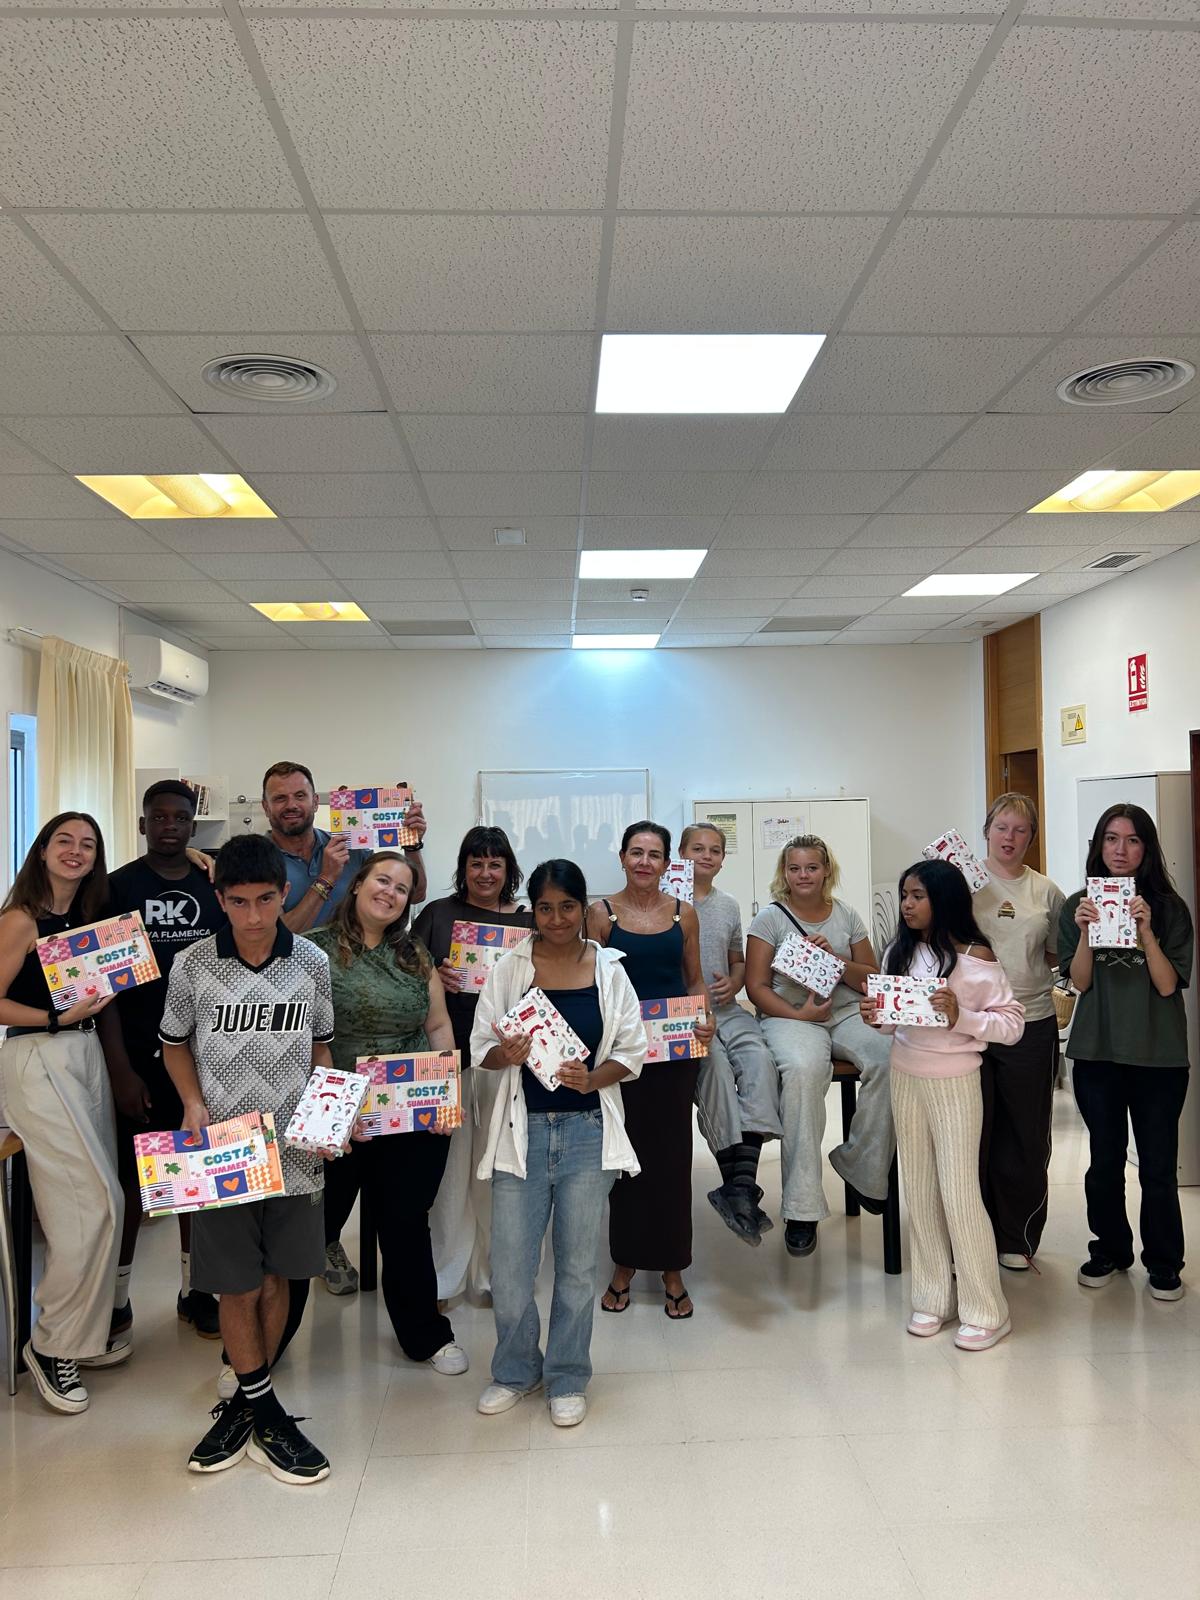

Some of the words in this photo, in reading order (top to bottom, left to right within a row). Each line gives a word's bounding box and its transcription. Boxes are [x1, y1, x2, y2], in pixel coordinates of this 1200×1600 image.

[372, 811, 404, 821] COSTA
[145, 899, 189, 925] RK
[161, 929, 211, 939] FLAMENCA
[96, 946, 136, 965] COSTA
[99, 958, 133, 974] SUMMER
[211, 1003, 270, 1032] JUVE
[662, 1032, 692, 1041] SUMMER
[407, 1085, 446, 1098] COSTA
[407, 1098, 441, 1108] SUMMER
[203, 1145, 253, 1166] COSTA
[205, 1160, 248, 1176] SUMMER
